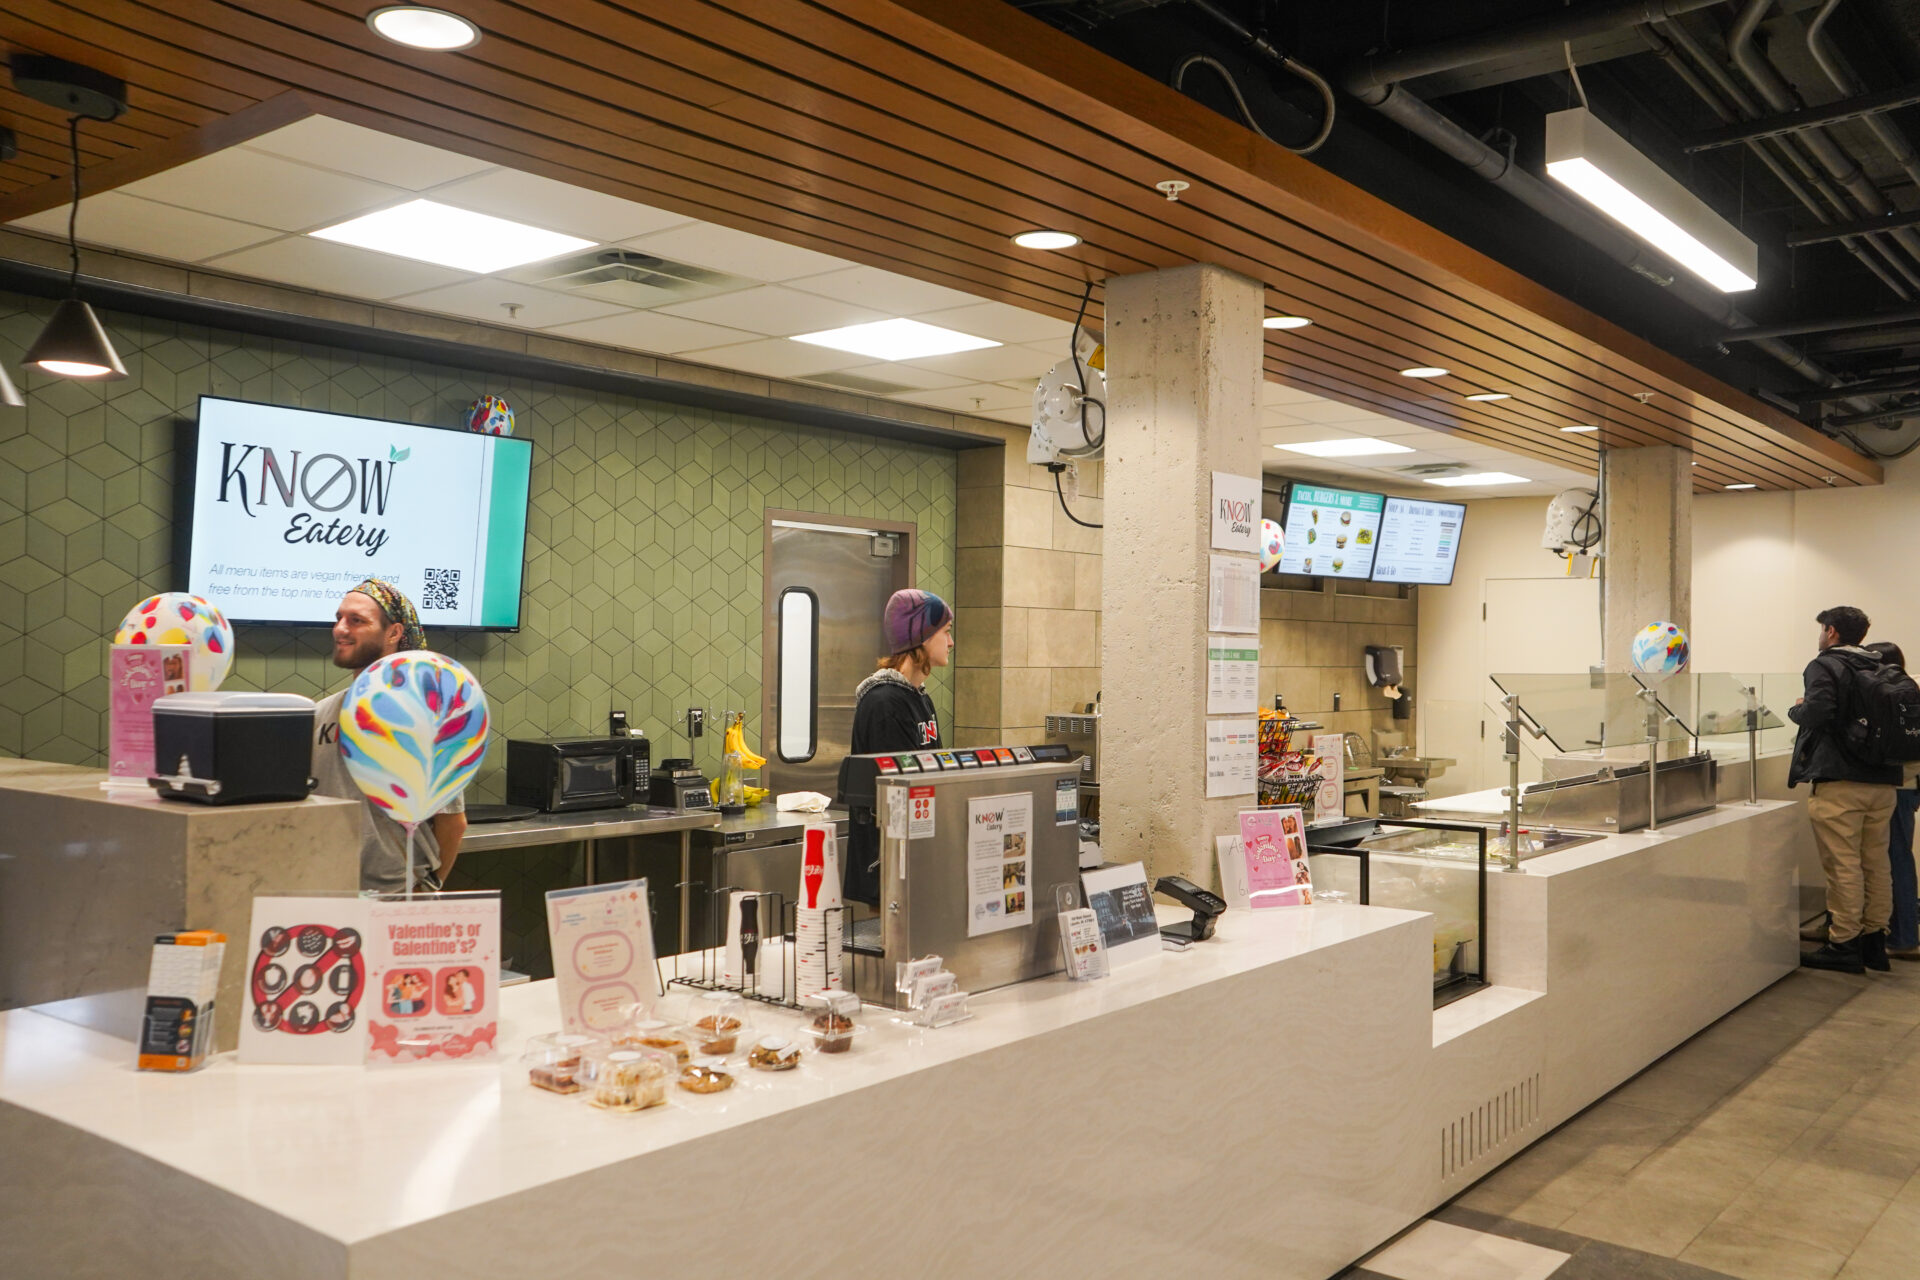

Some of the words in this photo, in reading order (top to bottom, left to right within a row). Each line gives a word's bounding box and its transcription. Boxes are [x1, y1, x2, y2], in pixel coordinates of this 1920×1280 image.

[216, 441, 396, 518] KNOW
[1220, 498, 1252, 524] KNOW
[284, 512, 390, 558] Eatery
[1231, 521, 1252, 538] Eatery
[208, 563, 225, 576] All
[226, 566, 258, 578] menu
[260, 567, 289, 580] items
[290, 571, 308, 580] are
[310, 572, 342, 584] vegan
[207, 583, 231, 595] free
[233, 583, 261, 597] from
[262, 585, 279, 598] the
[281, 586, 300, 600] top
[300, 588, 323, 599] nine
[975, 811, 1004, 824] KNOW
[388, 923, 463, 940] Valentine's
[467, 923, 482, 937] or
[393, 938, 477, 956] Galentine's?
